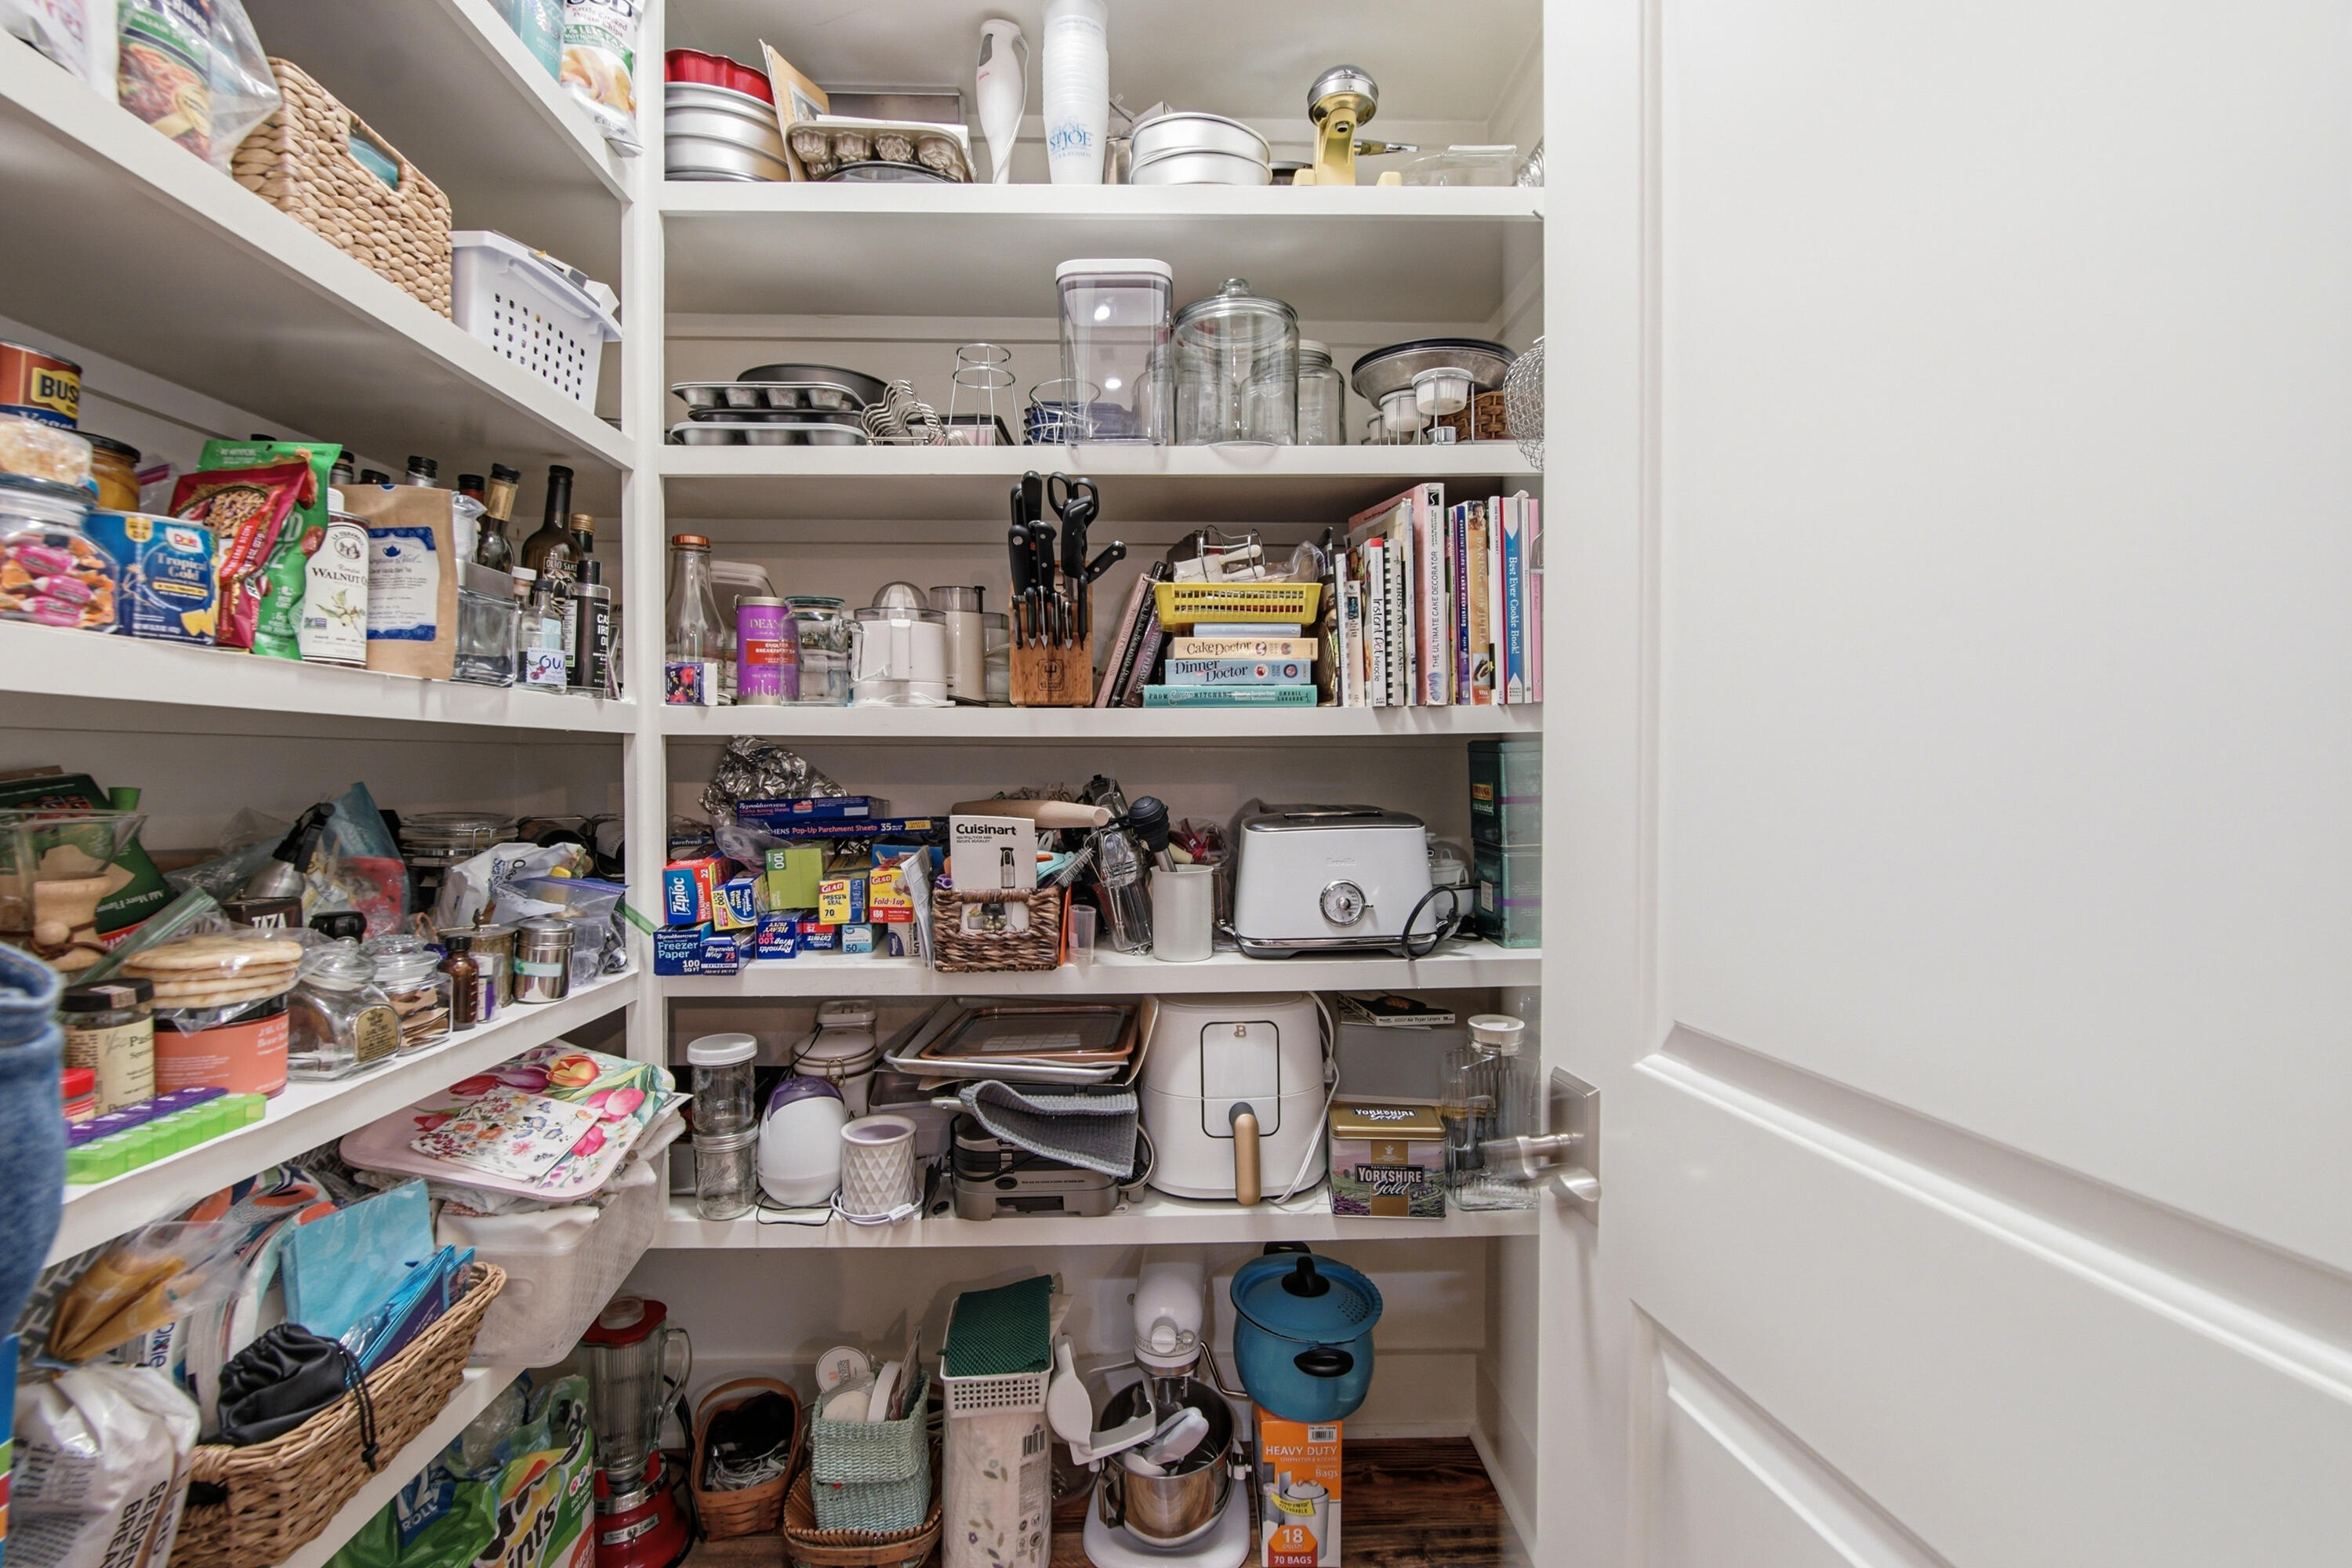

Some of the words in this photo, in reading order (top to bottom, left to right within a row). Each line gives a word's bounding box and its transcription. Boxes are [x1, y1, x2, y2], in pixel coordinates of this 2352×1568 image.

[158, 552, 206, 571] Tropical
[546, 559, 562, 570] OLIO
[564, 563, 578, 572] SANT
[1475, 537, 1487, 583] BAKING
[1508, 556, 1519, 575] Best
[168, 567, 199, 581] Gold
[311, 567, 360, 585] WALNUT
[1430, 550, 1439, 595] DECORATOR
[1509, 577, 1519, 597] Ever
[1431, 597, 1439, 616] CAKE
[1510, 599, 1520, 628] Cookie
[1373, 598, 1384, 636] Instant
[1478, 610, 1489, 645] JULIA
[1431, 620, 1440, 654] ULTIMATE
[1511, 630, 1520, 655] Book!
[1186, 642, 1214, 655] Cake
[1214, 641, 1252, 656] Doctor
[1374, 637, 1385, 659] Pot
[1175, 659, 1221, 675] Dinner
[1431, 654, 1440, 668] THE
[1206, 665, 1248, 683] Doctor
[880, 822, 891, 832] 35
[956, 823, 1017, 836] Cuisinart
[773, 851, 785, 869] 100
[821, 882, 843, 893] GLAD
[871, 876, 891, 884] GLAD
[672, 877, 690, 913] Ziploc
[716, 892, 725, 906] 200
[251, 913, 287, 928] TAZA
[825, 909, 835, 917] 70
[659, 941, 698, 951] Freezer
[757, 937, 774, 946] 100
[773, 937, 795, 948] Wrap
[659, 949, 690, 961] Paper
[707, 945, 735, 954] Reynolds
[758, 945, 793, 954] Reynolds
[682, 959, 700, 968] 100
[1356, 1108, 1416, 1117] YORKSHIRE
[1357, 1167, 1422, 1183] YORKSHIRE
[1371, 1178, 1412, 1196] Gold
[1265, 1446, 1303, 1456] HEAVY
[1307, 1446, 1338, 1456] DUTY
[1315, 1467, 1339, 1479] Bags
[100, 1498, 143, 1568] BREA
[1282, 1528, 1304, 1544] 18
[1274, 1555, 1284, 1565] 70
[1287, 1555, 1312, 1565] BAGS
